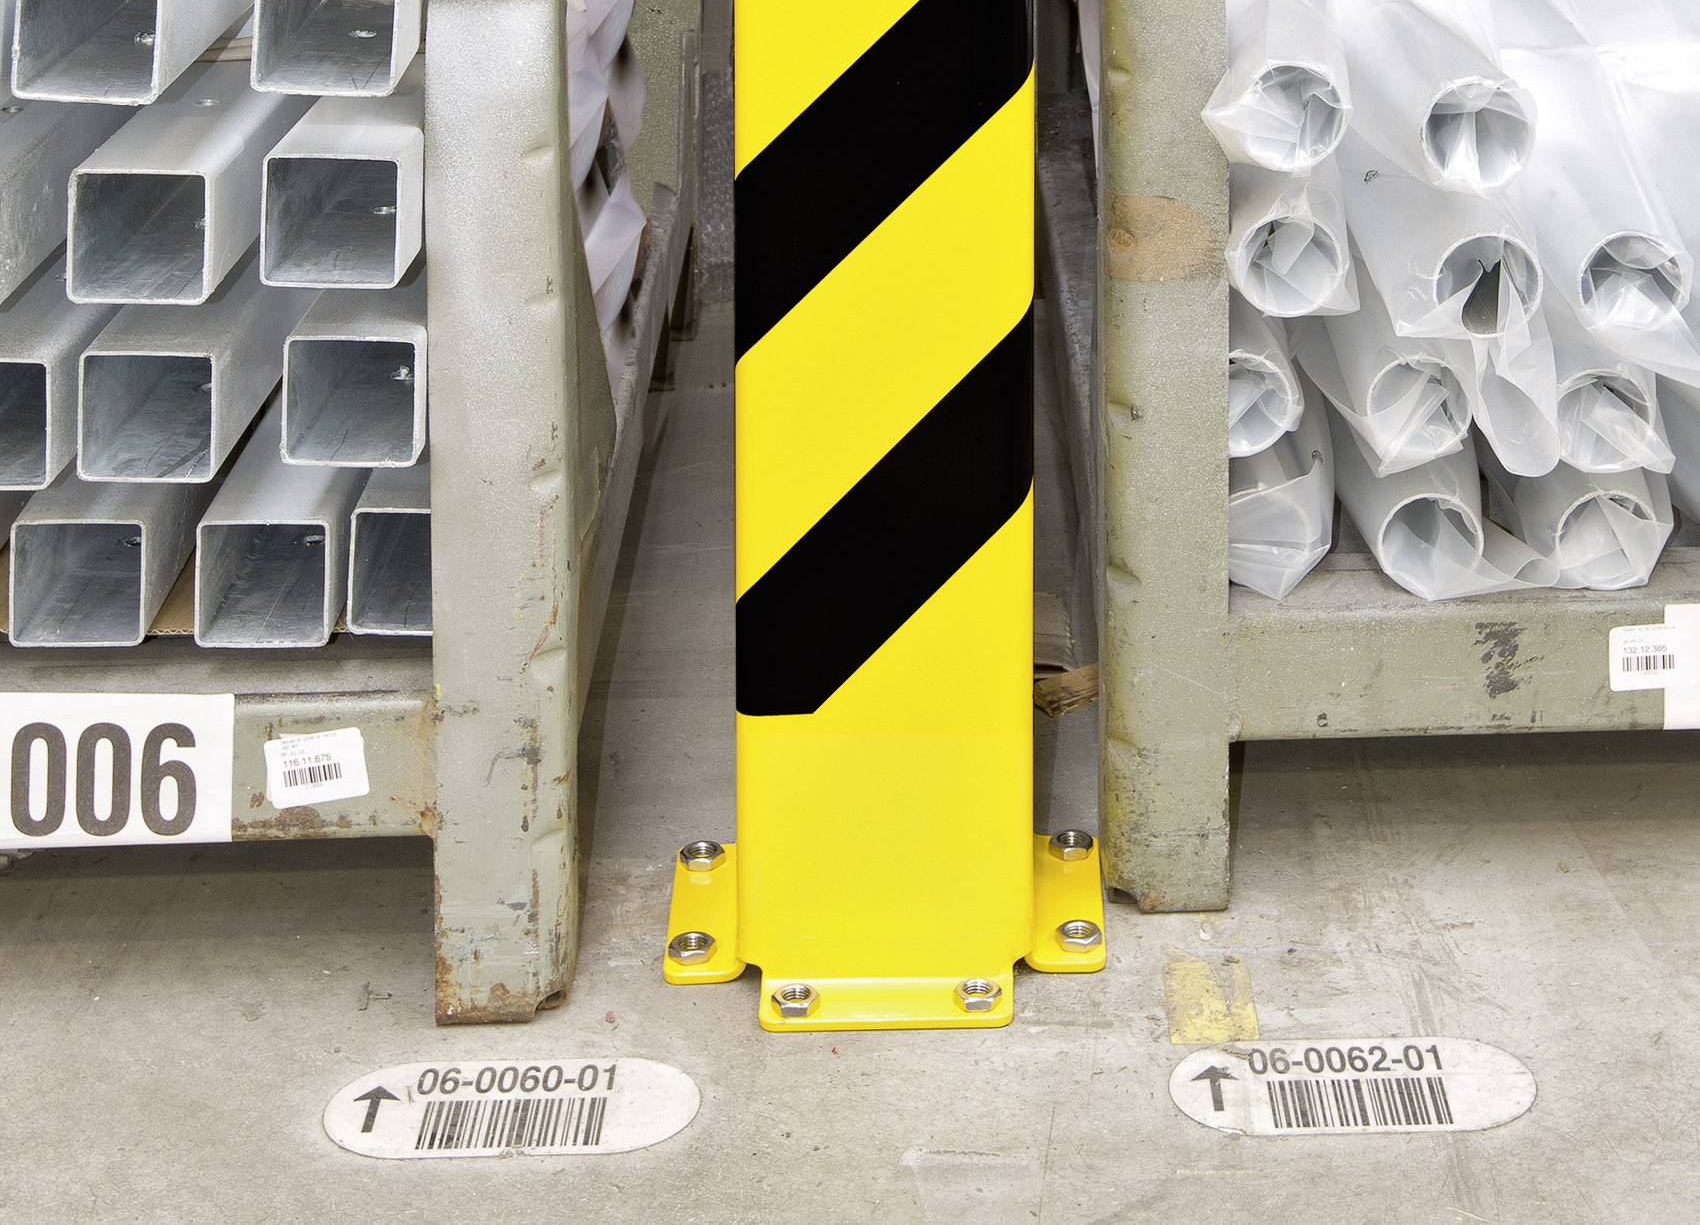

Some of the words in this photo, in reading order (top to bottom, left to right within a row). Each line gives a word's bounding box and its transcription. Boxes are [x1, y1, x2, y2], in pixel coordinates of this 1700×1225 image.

[283, 753, 332, 768] 116.11.675
[10, 722, 197, 837] 006
[1248, 1044, 1443, 1075] 06-0062-01
[416, 1063, 617, 1096] 06-0060-01
